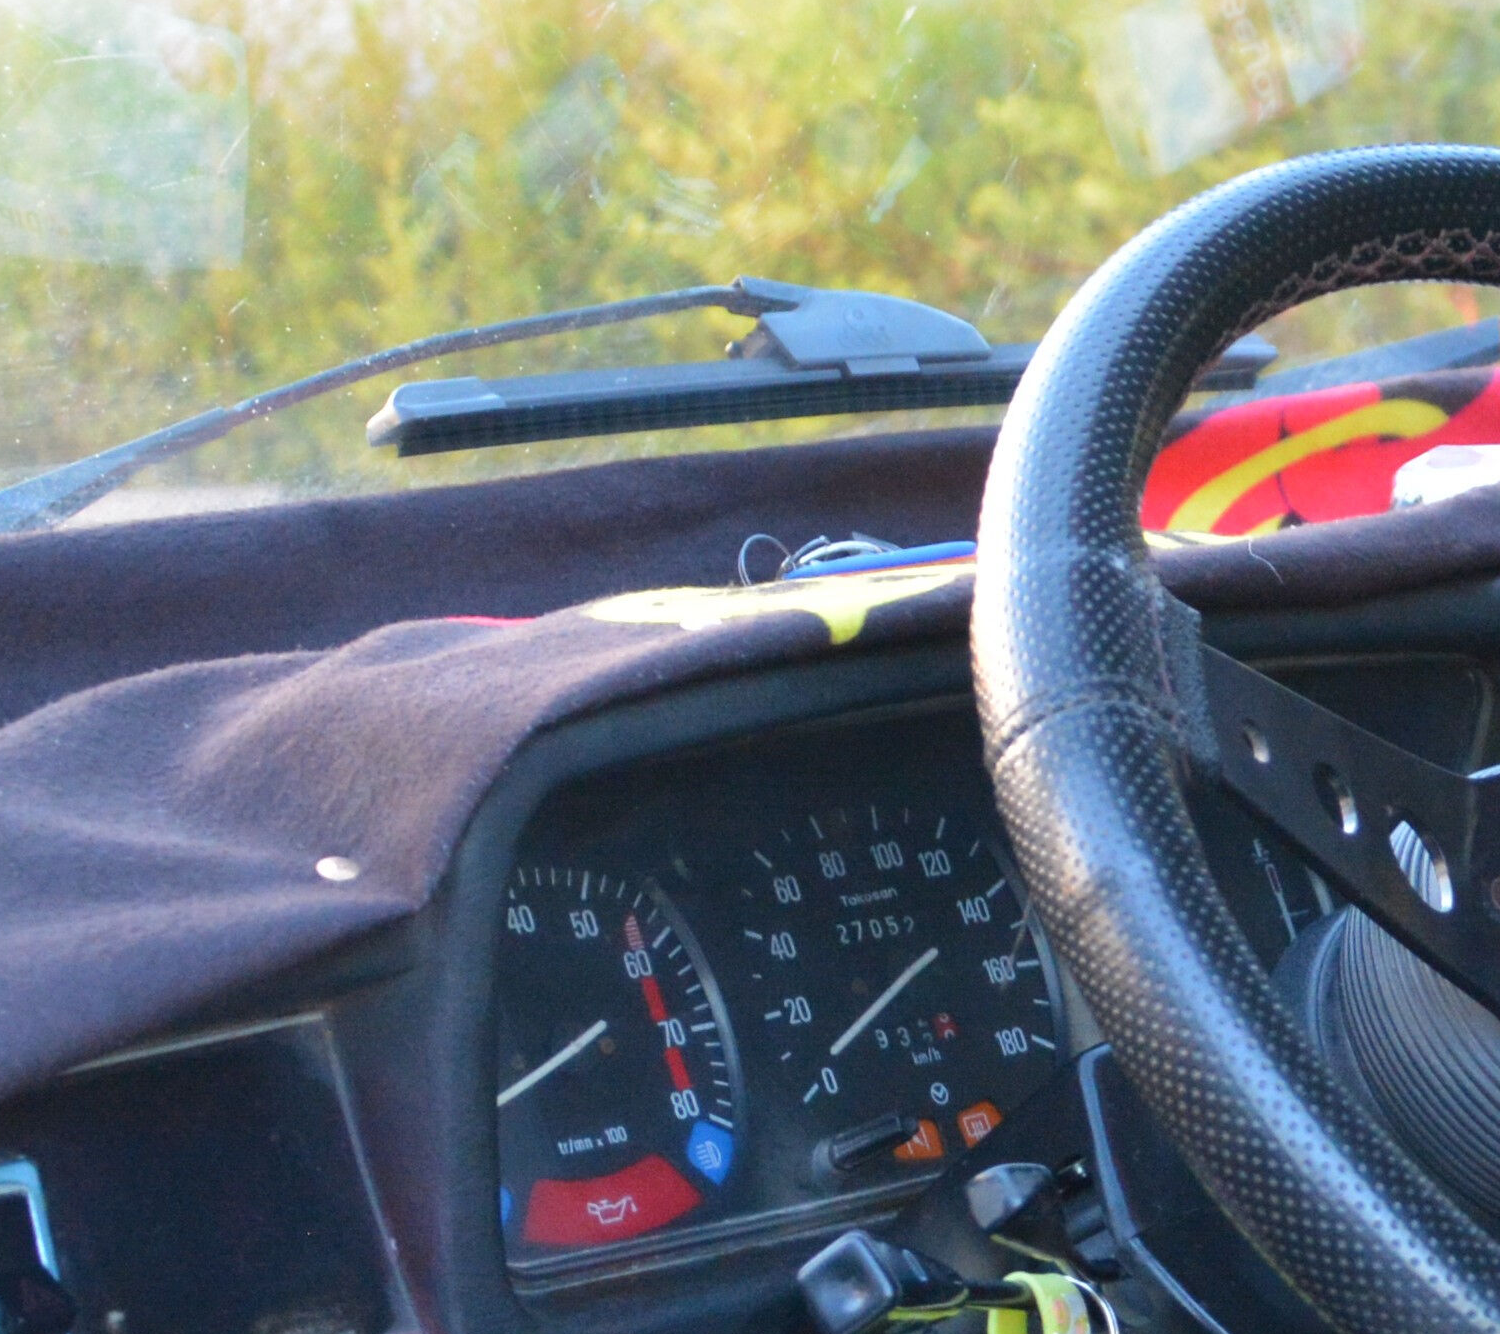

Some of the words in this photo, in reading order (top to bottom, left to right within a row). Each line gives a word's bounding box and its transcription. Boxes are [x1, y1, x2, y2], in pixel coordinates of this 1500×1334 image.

[819, 850, 846, 879] 80
[869, 841, 904, 870] 100
[917, 849, 952, 878] 120
[773, 875, 801, 904] 60
[507, 905, 536, 935] 40
[569, 910, 599, 940] 50
[956, 896, 990, 925] 140
[770, 932, 797, 960] 40
[623, 950, 652, 979] 60
[982, 955, 1016, 984] 160
[783, 996, 812, 1025] 20
[657, 1018, 686, 1048] 70
[995, 1026, 1028, 1057] 180
[911, 1046, 941, 1065] km/h
[821, 1067, 838, 1095] 0
[670, 1089, 699, 1120] 80
[557, 1136, 594, 1156] tr/mn
[604, 1125, 628, 1144] 100
